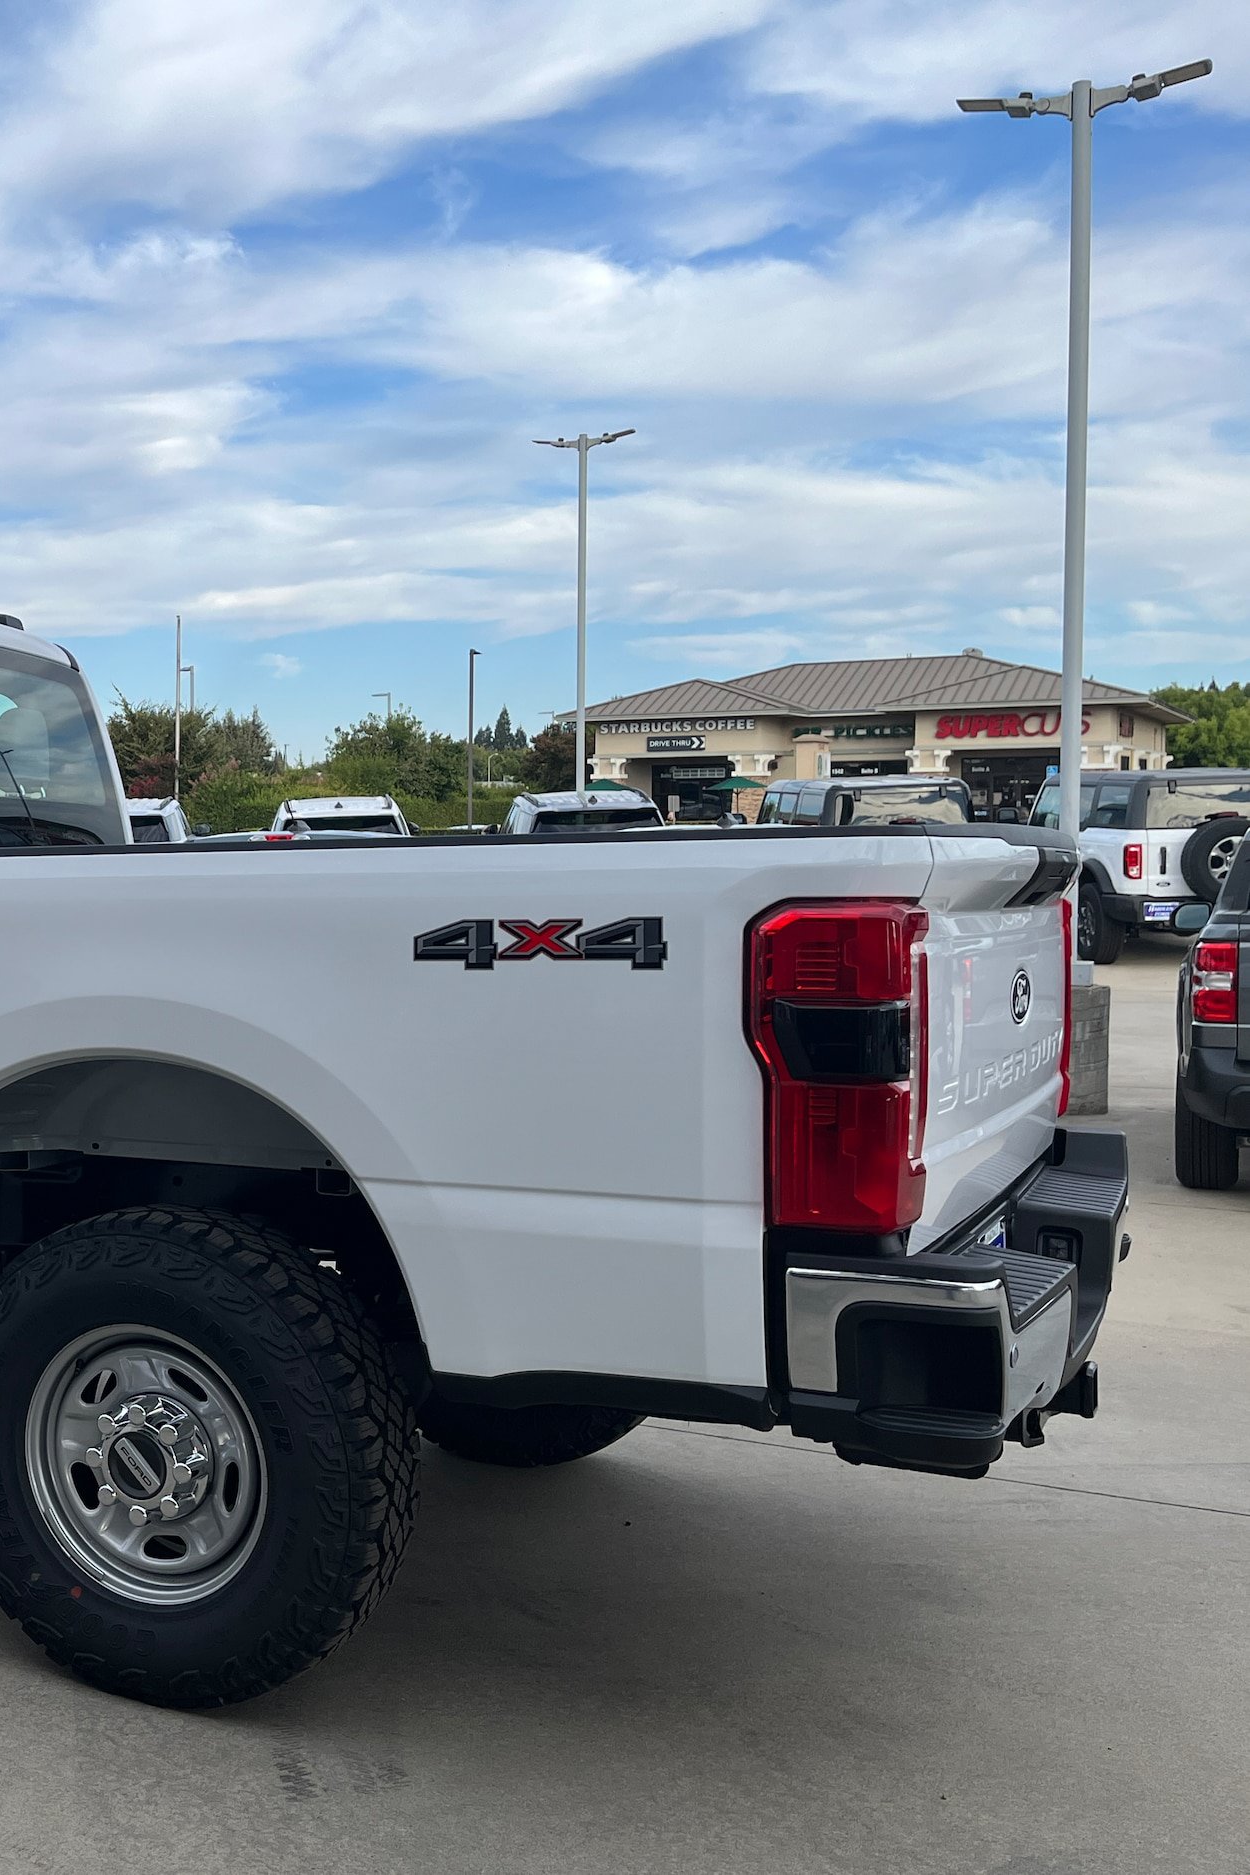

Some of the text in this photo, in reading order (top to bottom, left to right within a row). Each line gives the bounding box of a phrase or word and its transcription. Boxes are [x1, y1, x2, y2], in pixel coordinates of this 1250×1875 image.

[600, 719, 755, 734] STARBUCKS COFFEE
[935, 711, 1092, 739] SUPERCUS
[649, 739, 692, 748] DRIVE THRU
[120, 1446, 152, 1486] FORD
